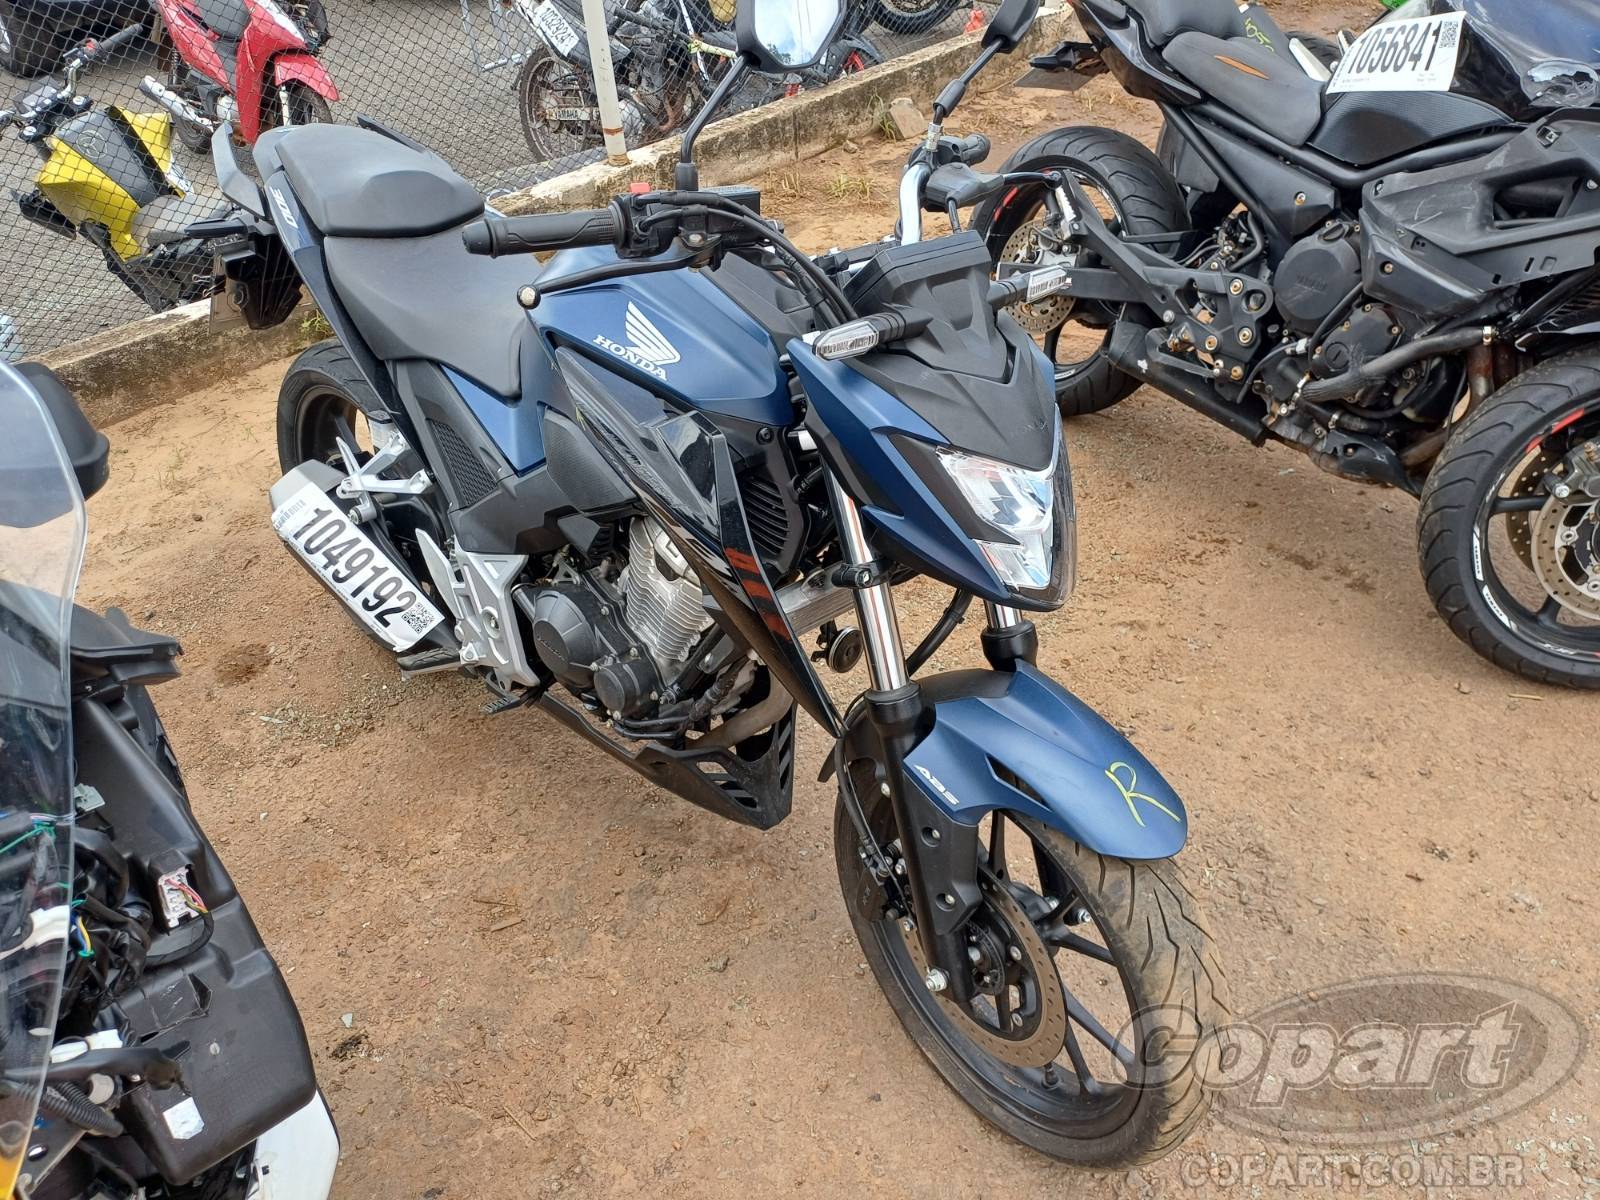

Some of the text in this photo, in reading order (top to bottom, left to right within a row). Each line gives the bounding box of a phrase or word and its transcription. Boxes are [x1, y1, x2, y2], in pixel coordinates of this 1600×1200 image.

[1348, 20, 1442, 74] 1056841
[269, 186, 299, 229] 300
[592, 334, 668, 381] HONDA
[293, 507, 417, 628] 1049192
[913, 764, 960, 805] ABS
[1105, 762, 1181, 827] R
